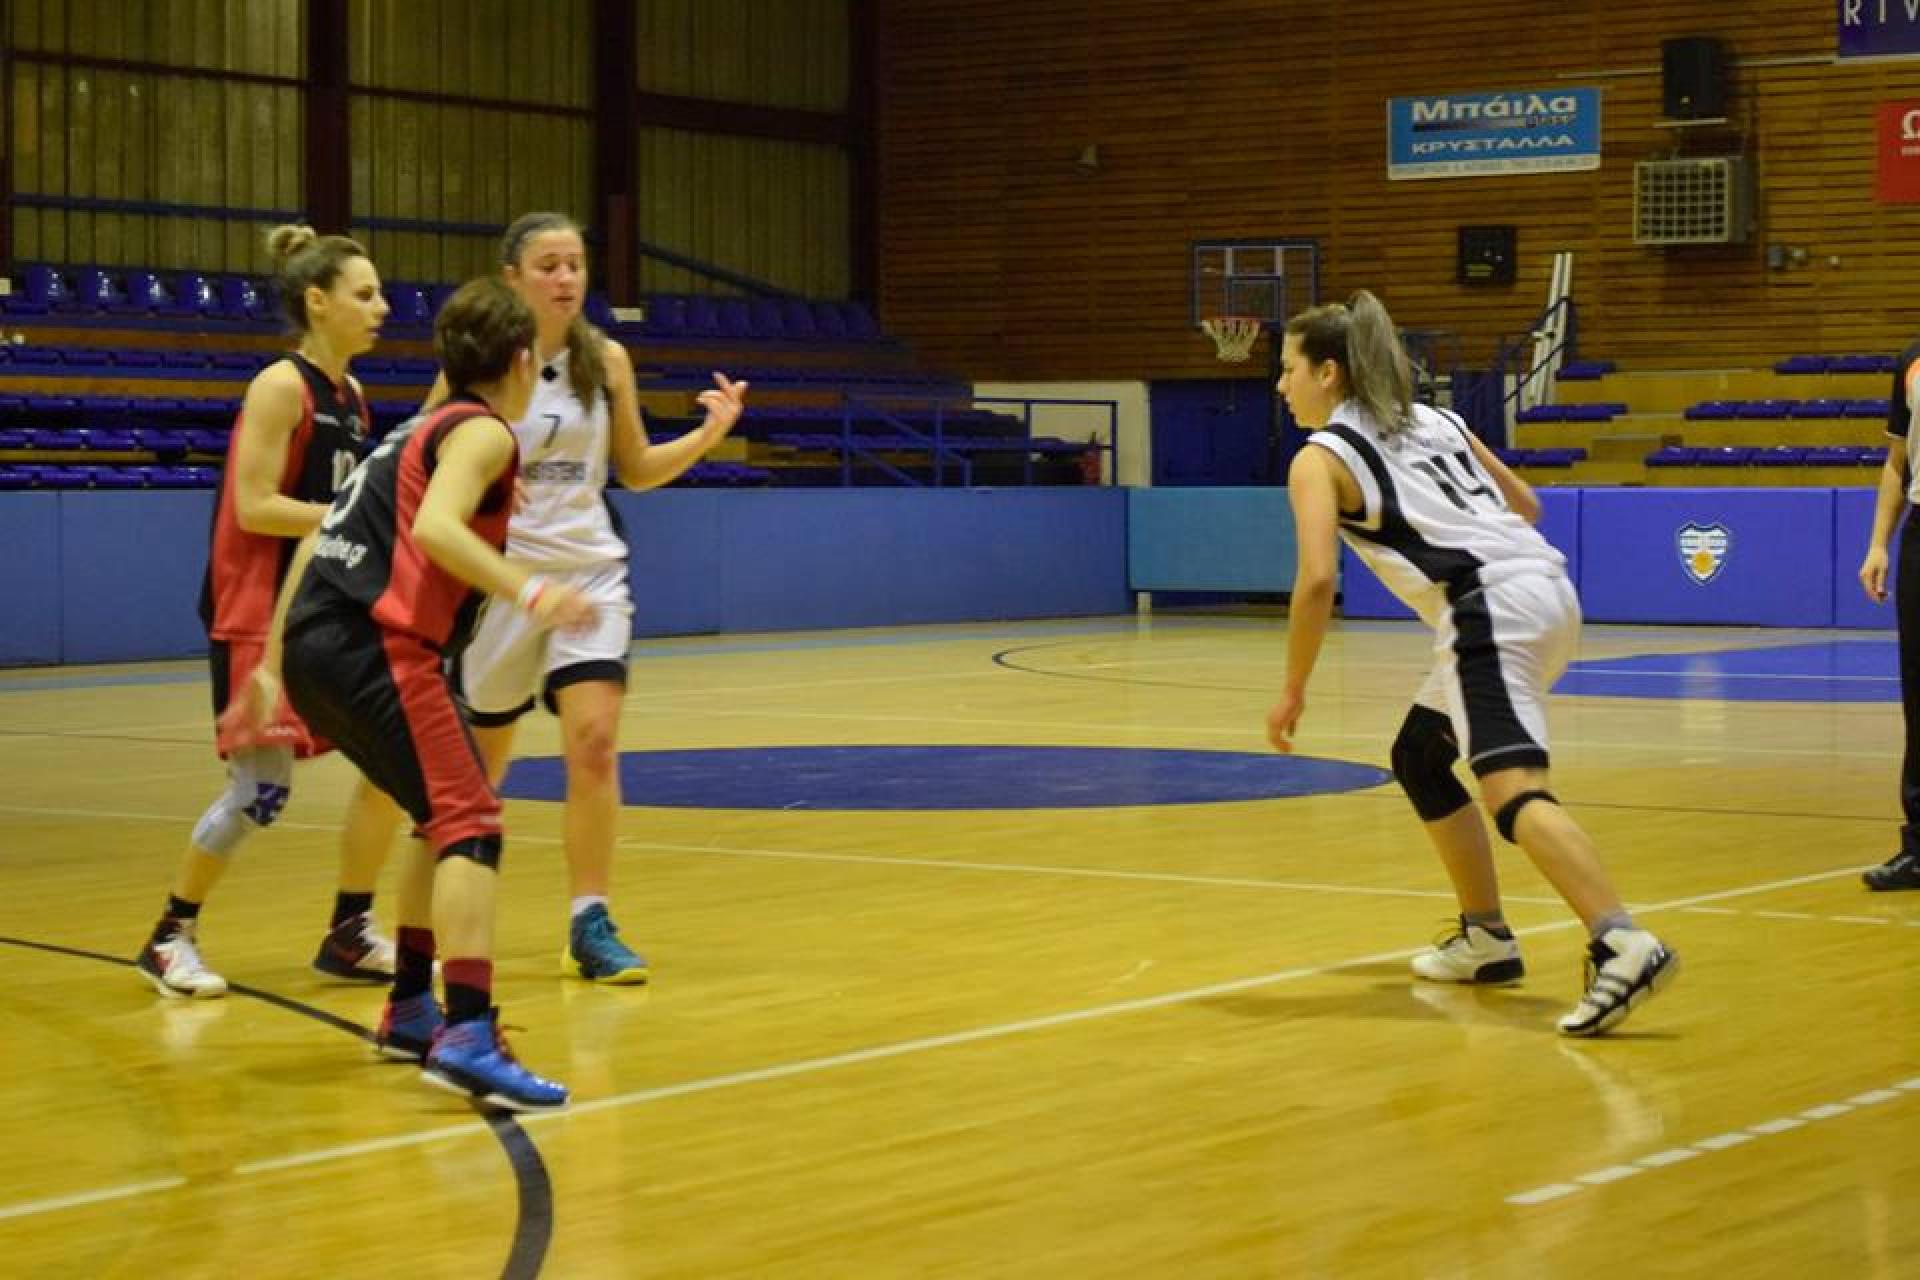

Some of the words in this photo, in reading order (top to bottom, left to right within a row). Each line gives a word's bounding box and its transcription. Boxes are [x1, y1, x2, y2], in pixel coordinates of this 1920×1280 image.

[1412, 94, 1577, 121] Μπάιλα
[541, 413, 561, 449] 7
[1411, 451, 1501, 515] 14
